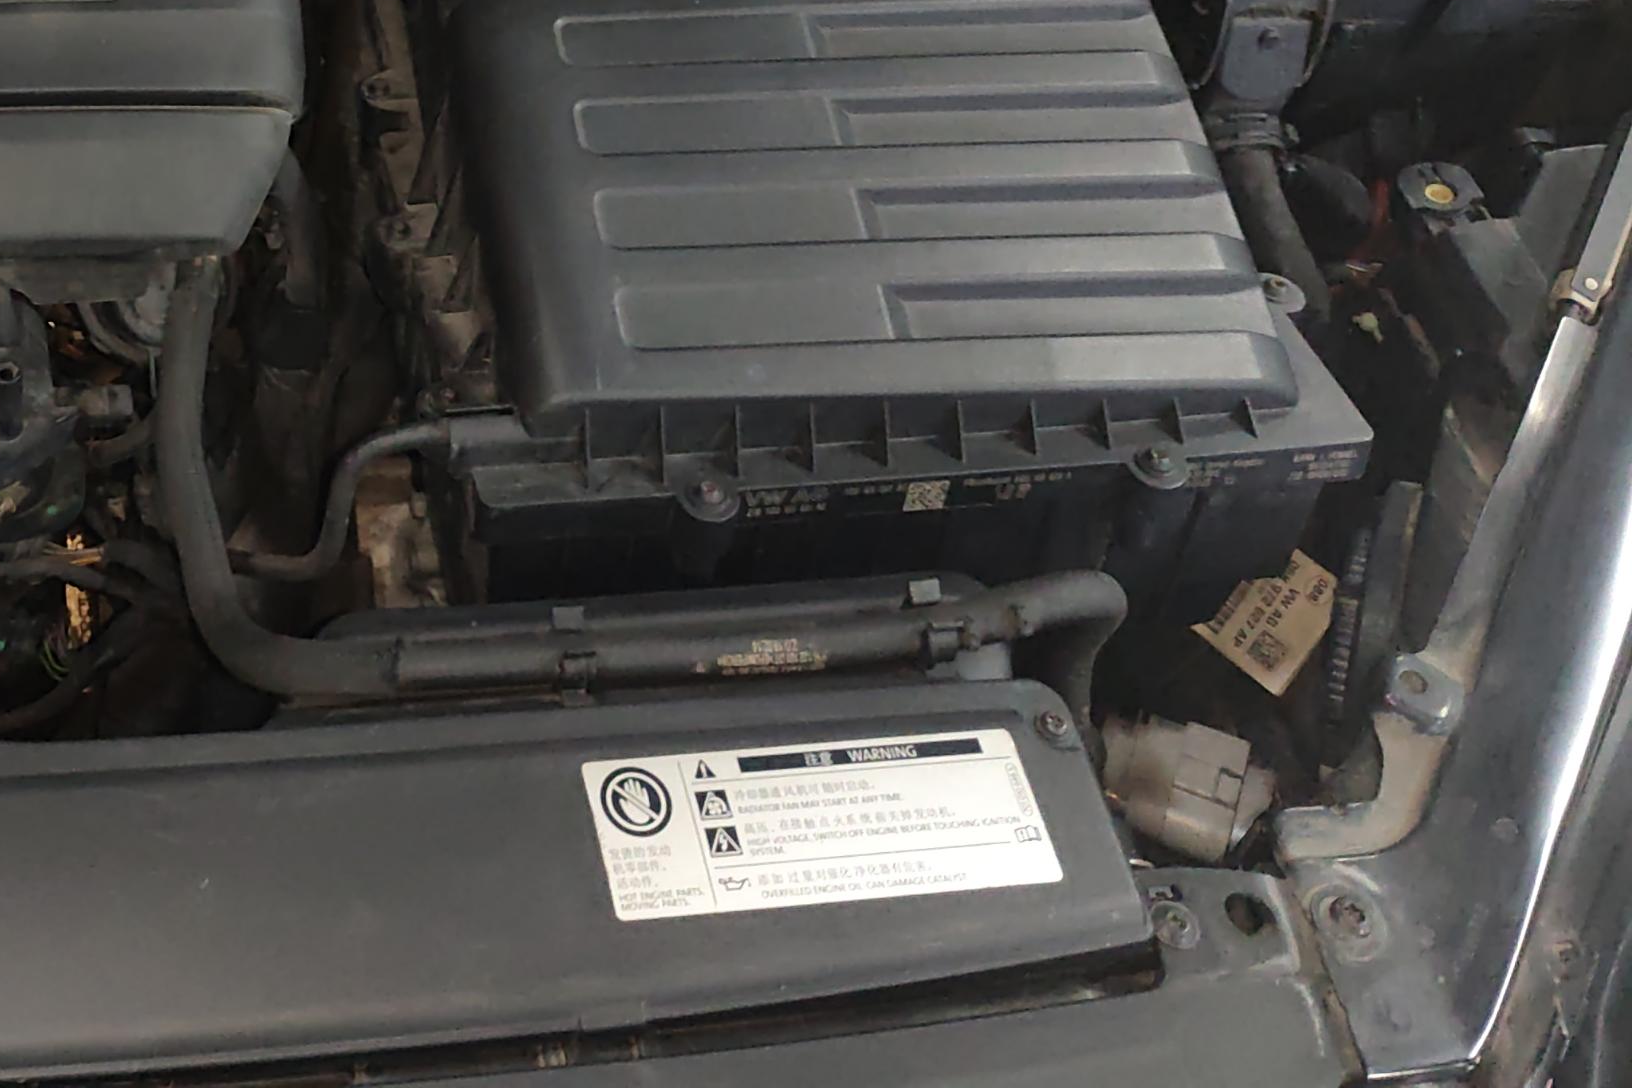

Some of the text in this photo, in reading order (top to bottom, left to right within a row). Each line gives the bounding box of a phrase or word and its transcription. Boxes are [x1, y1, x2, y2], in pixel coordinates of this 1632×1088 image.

[1279, 588, 1300, 610] VW
[847, 744, 917, 763] WARNING
[782, 801, 800, 811] FAN
[801, 799, 820, 810] MAY
[822, 797, 847, 808] START
[813, 831, 847, 842] SWITCH
[849, 829, 864, 838] OFF
[866, 826, 898, 836] ENGINE
[901, 823, 932, 833] BEFORE
